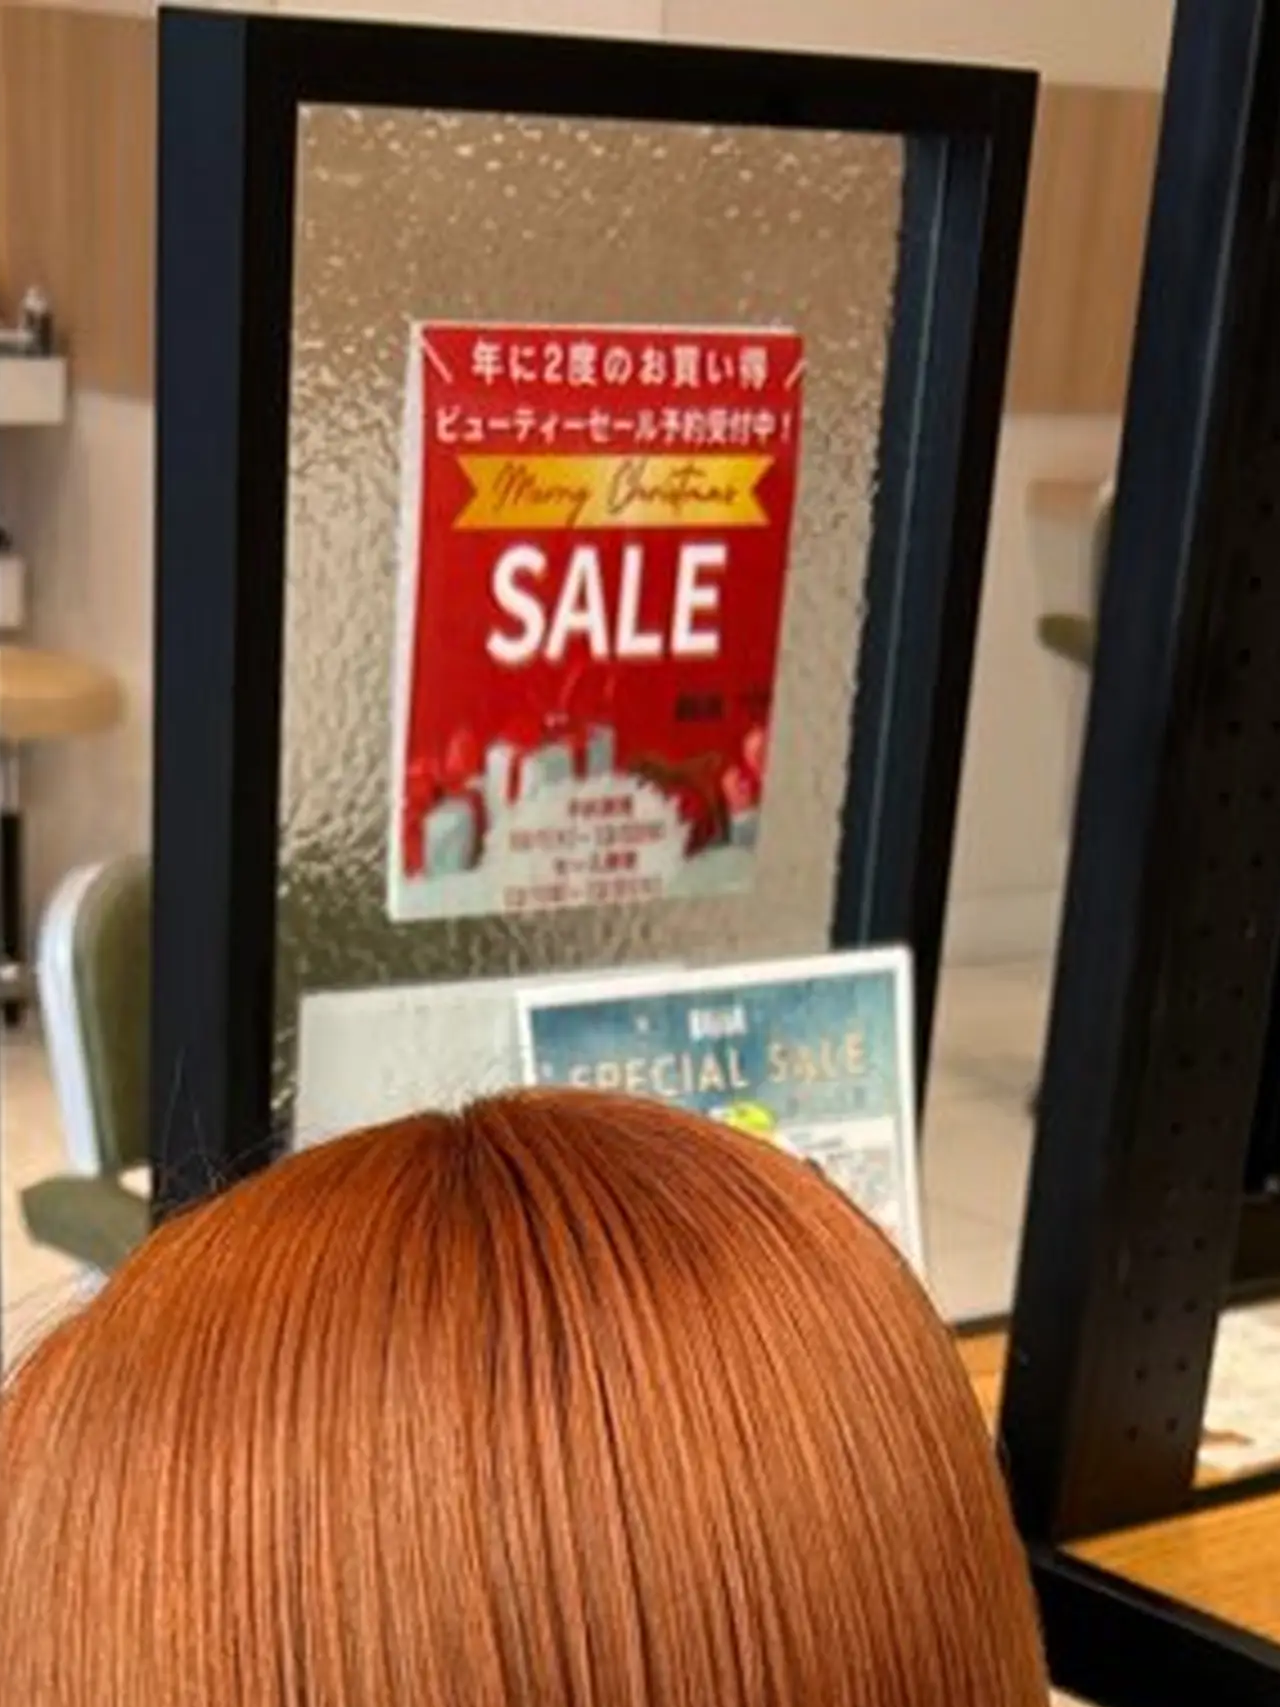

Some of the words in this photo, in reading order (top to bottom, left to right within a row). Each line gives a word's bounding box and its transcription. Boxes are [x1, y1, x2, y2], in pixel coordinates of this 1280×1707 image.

[471, 338, 768, 388] 年に2度のお買い得
[491, 460, 588, 527] Merry
[607, 457, 738, 515] Christmas
[486, 541, 727, 666] SALE
[572, 1048, 750, 1097] SPECIAL
[768, 1028, 866, 1084] SALE
